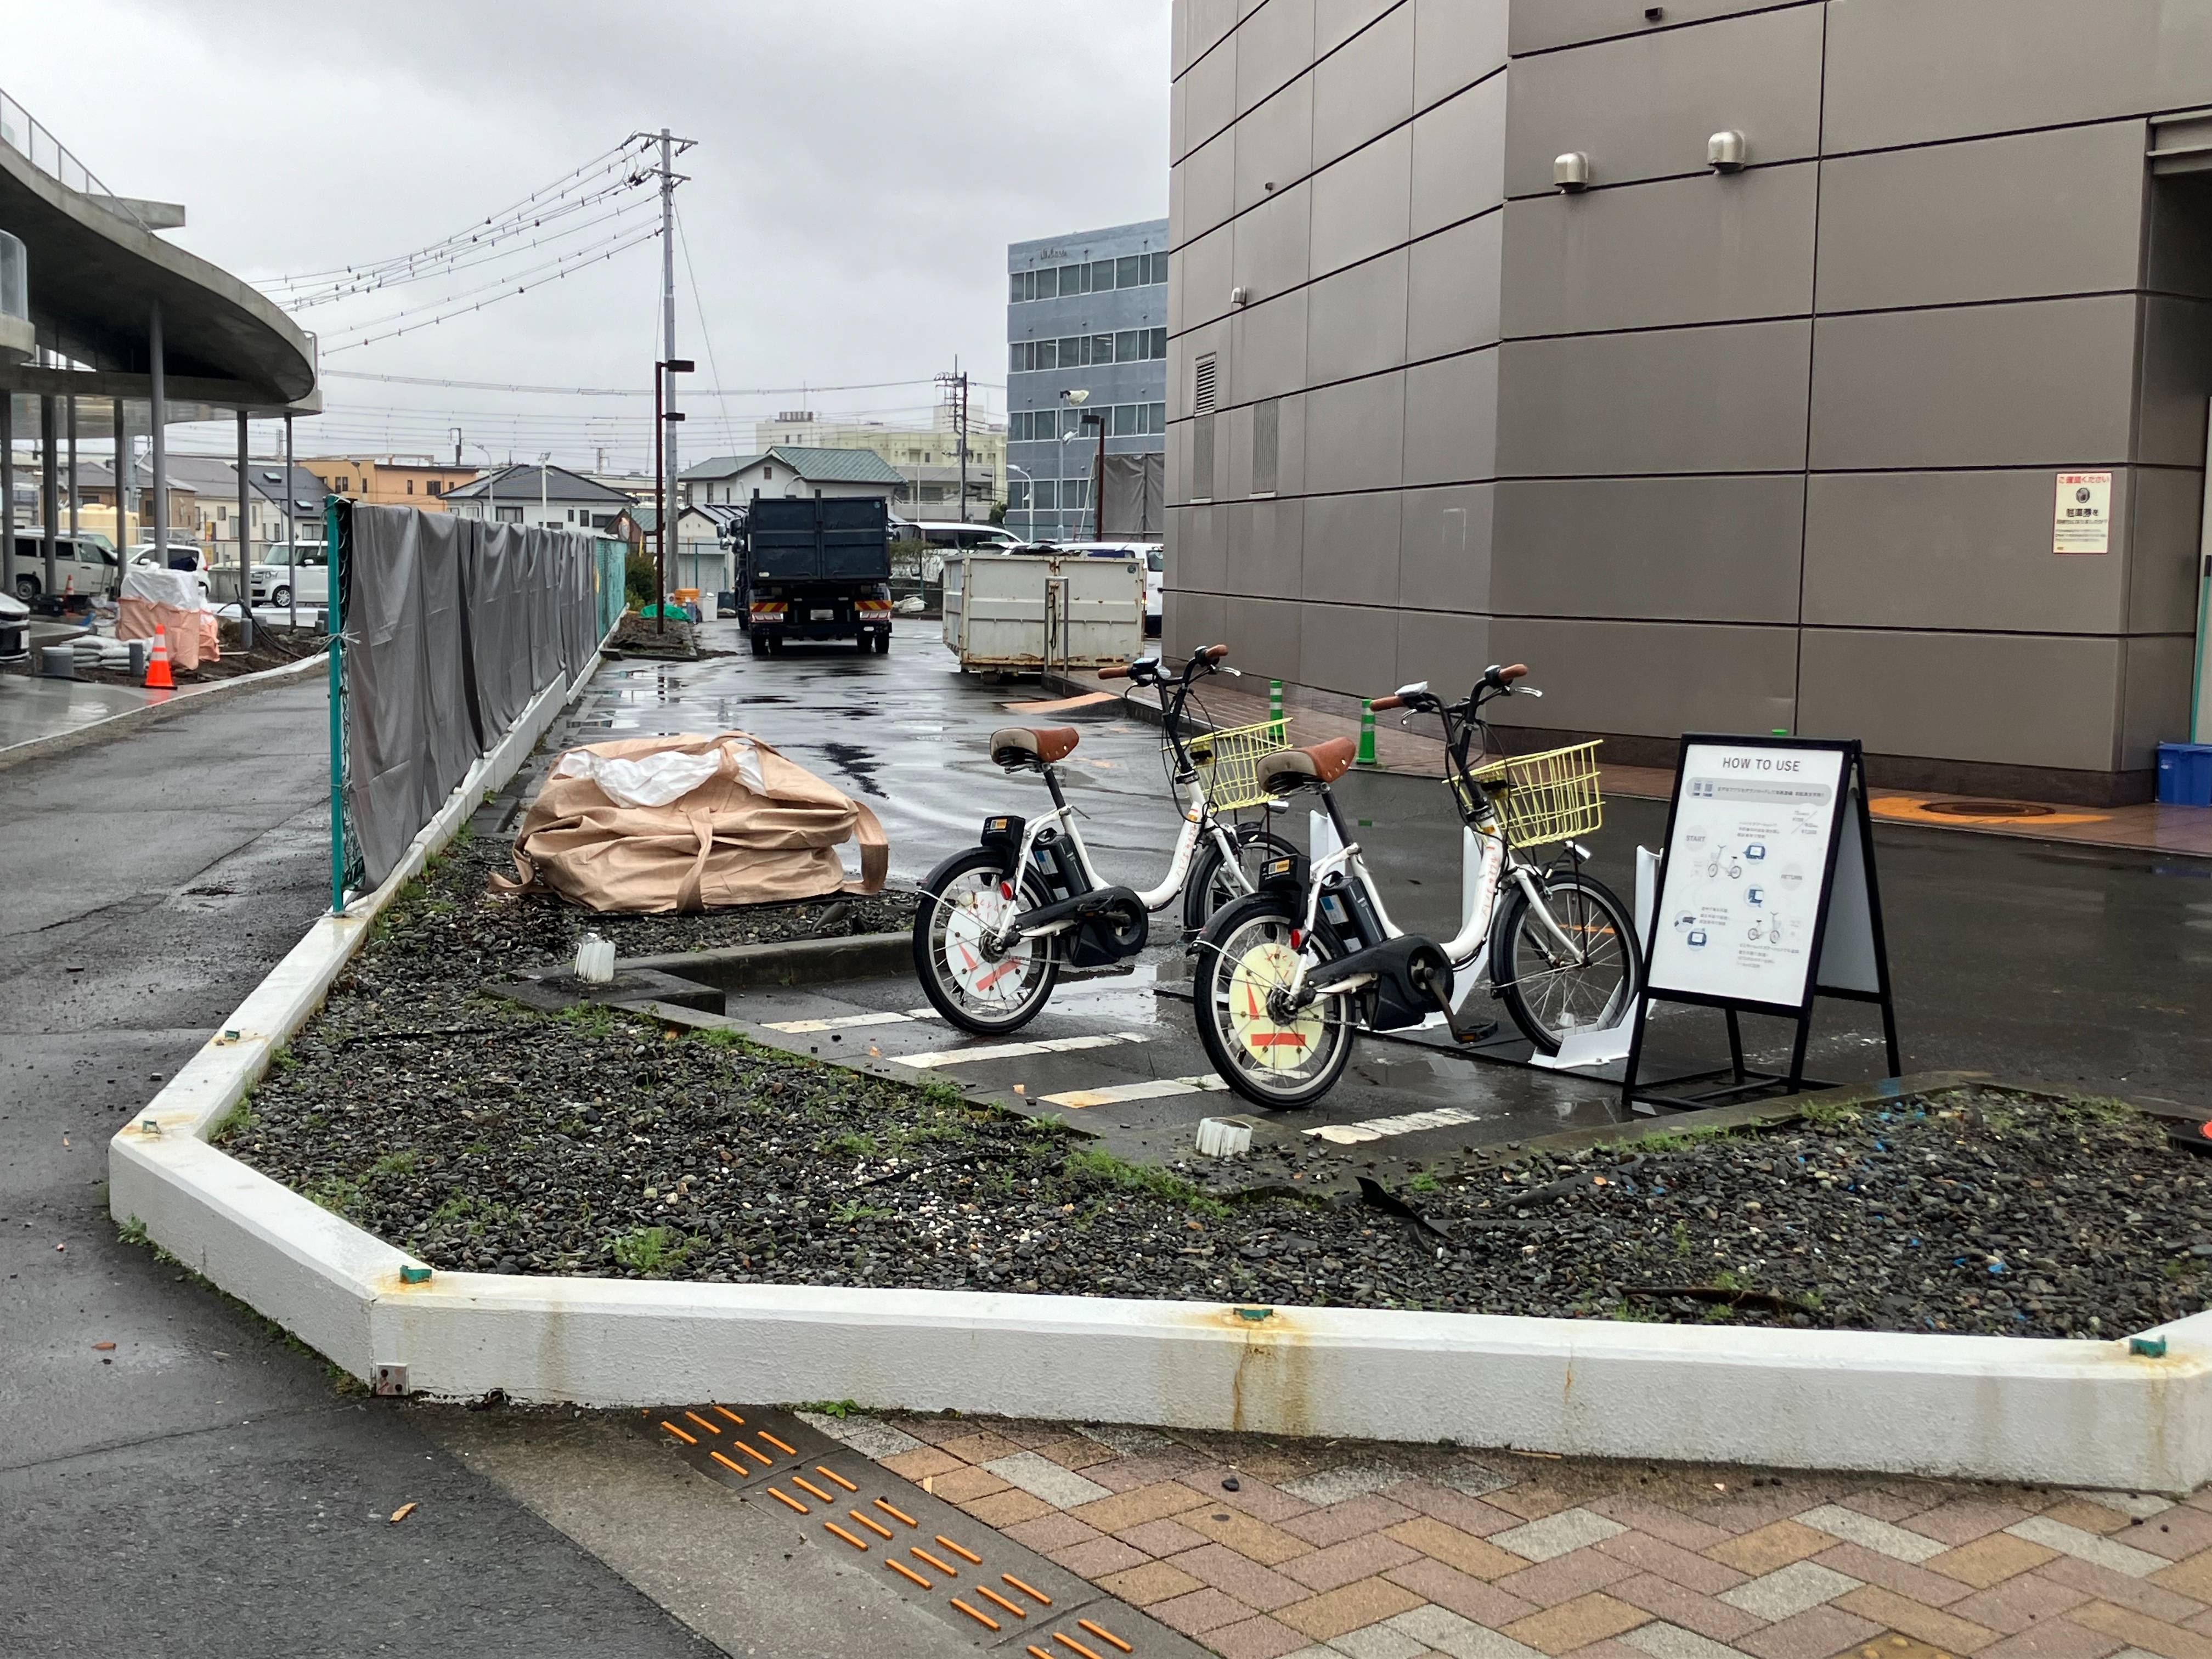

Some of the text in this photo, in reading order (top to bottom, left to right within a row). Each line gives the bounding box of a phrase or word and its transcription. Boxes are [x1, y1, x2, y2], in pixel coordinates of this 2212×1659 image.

[1723, 757, 1801, 771] HOW TO USE
